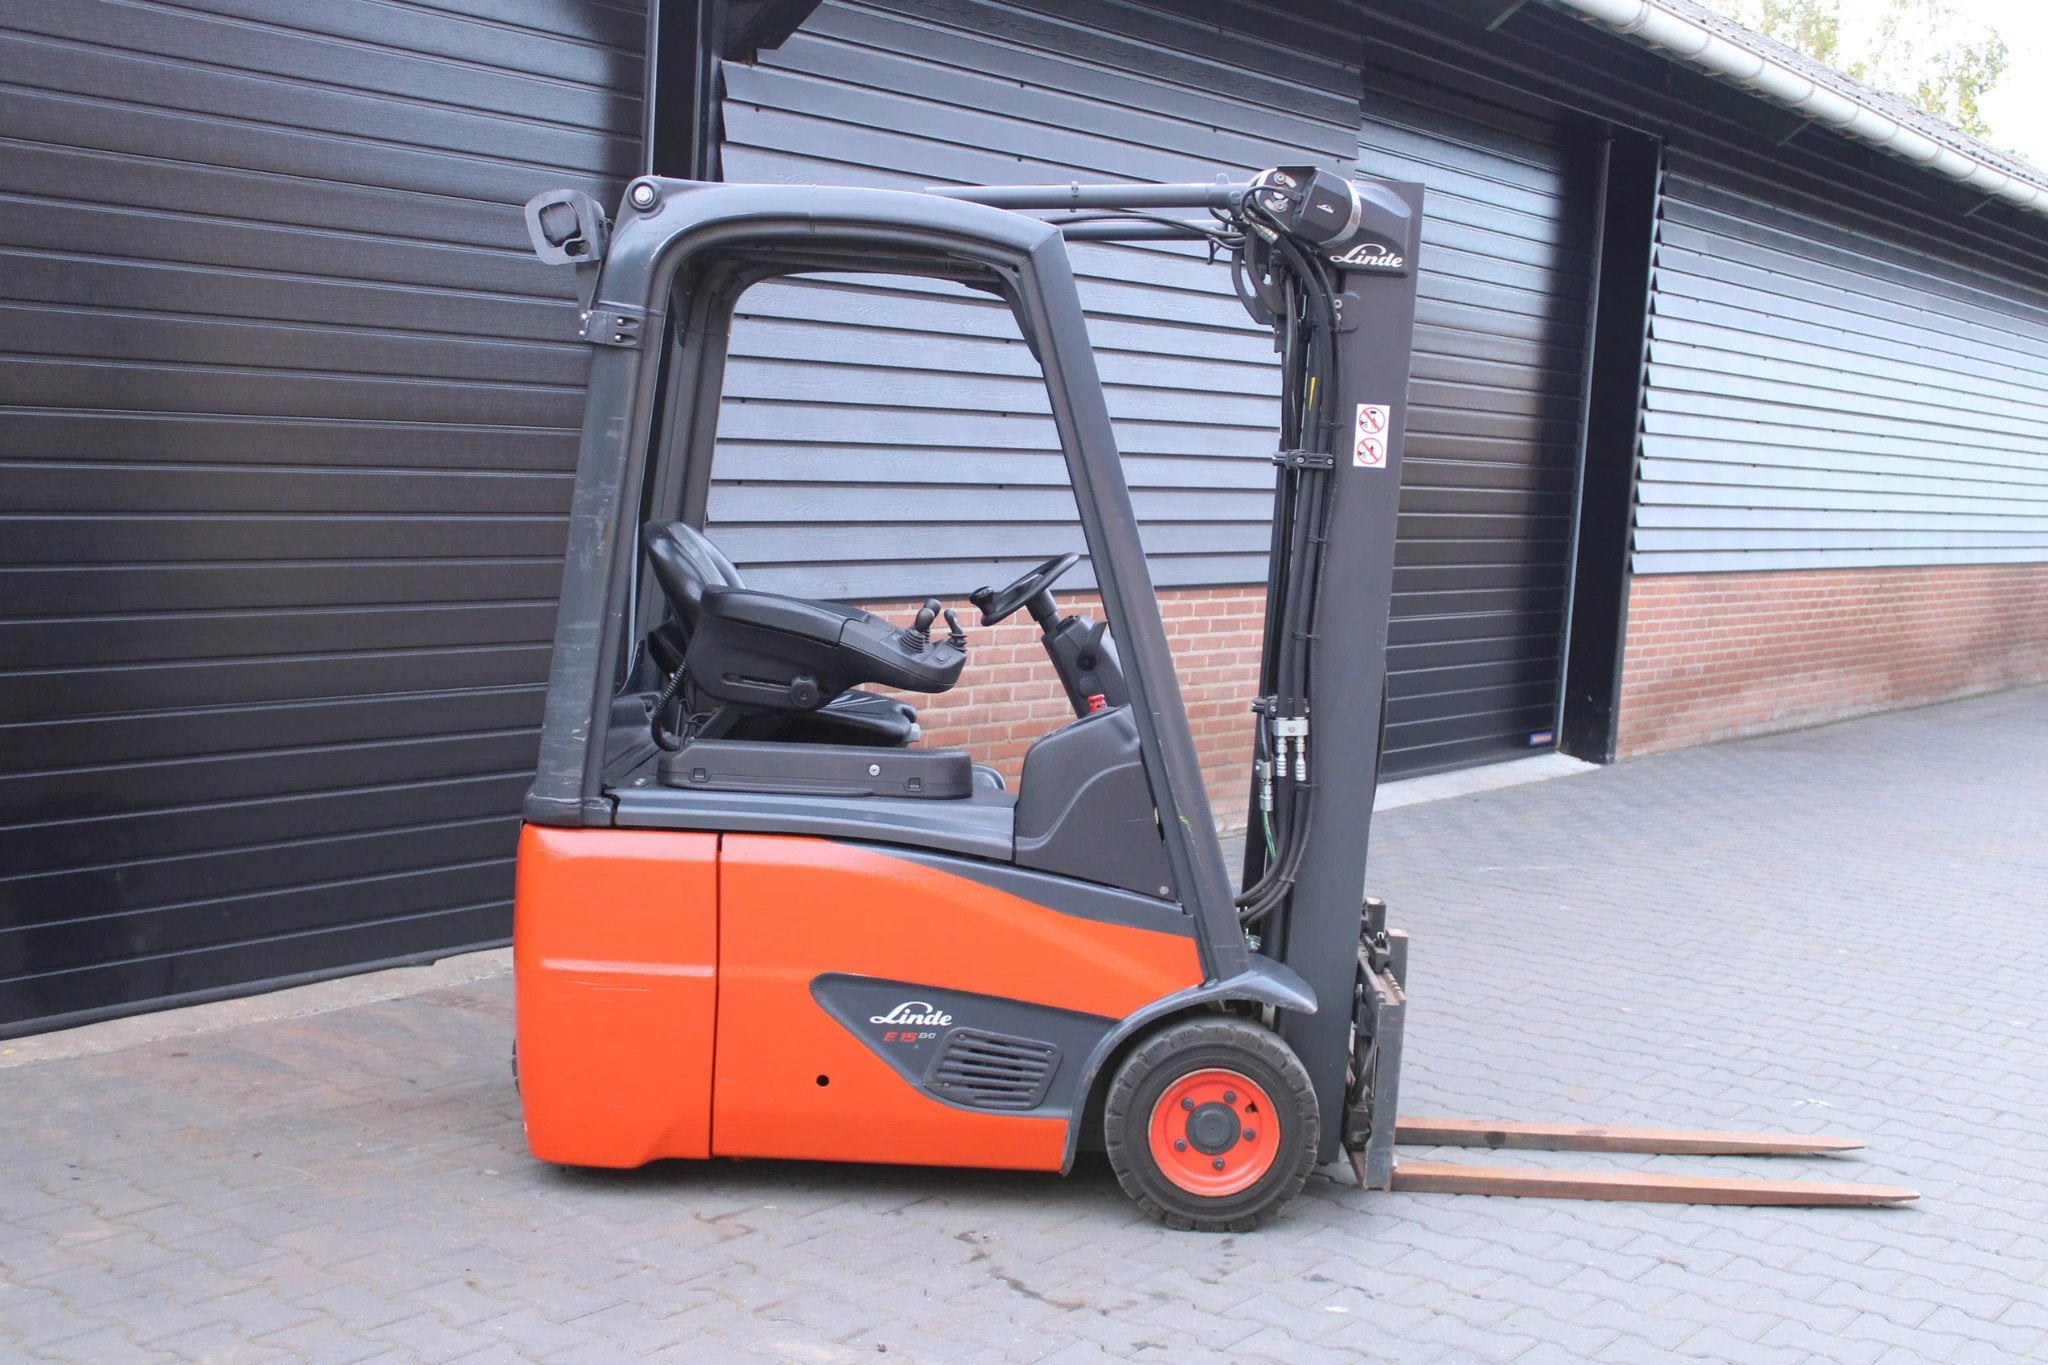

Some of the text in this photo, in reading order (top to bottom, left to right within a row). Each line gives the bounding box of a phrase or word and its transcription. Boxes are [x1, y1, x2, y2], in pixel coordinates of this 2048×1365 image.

[1330, 243, 1403, 268] Linde
[869, 1001, 953, 1026] Linde
[883, 1031, 898, 1042] E
[899, 1031, 918, 1043] 15
